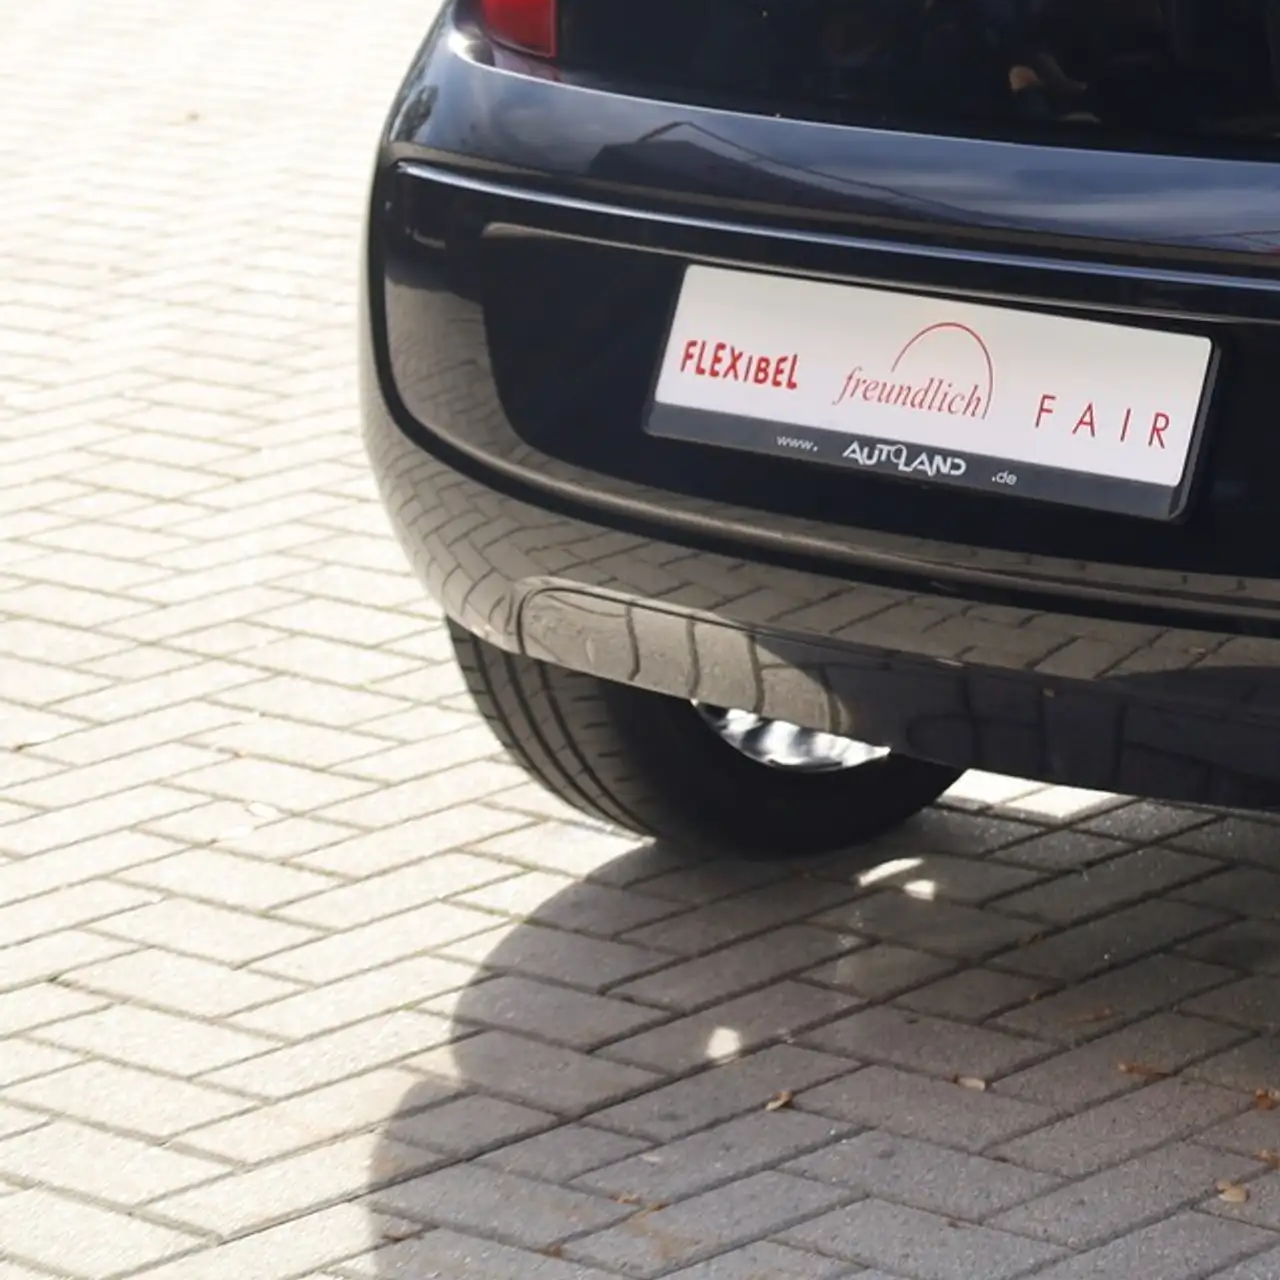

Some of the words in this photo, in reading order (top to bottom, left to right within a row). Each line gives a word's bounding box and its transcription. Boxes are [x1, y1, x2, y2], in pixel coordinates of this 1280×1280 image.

[680, 339, 798, 390] FLEXIBEL
[831, 366, 982, 418] freundlich
[1034, 393, 1170, 449] FAIR
[776, 435, 819, 452] www.
[842, 440, 967, 476] AUTOLAND
[991, 470, 1018, 486] .de
